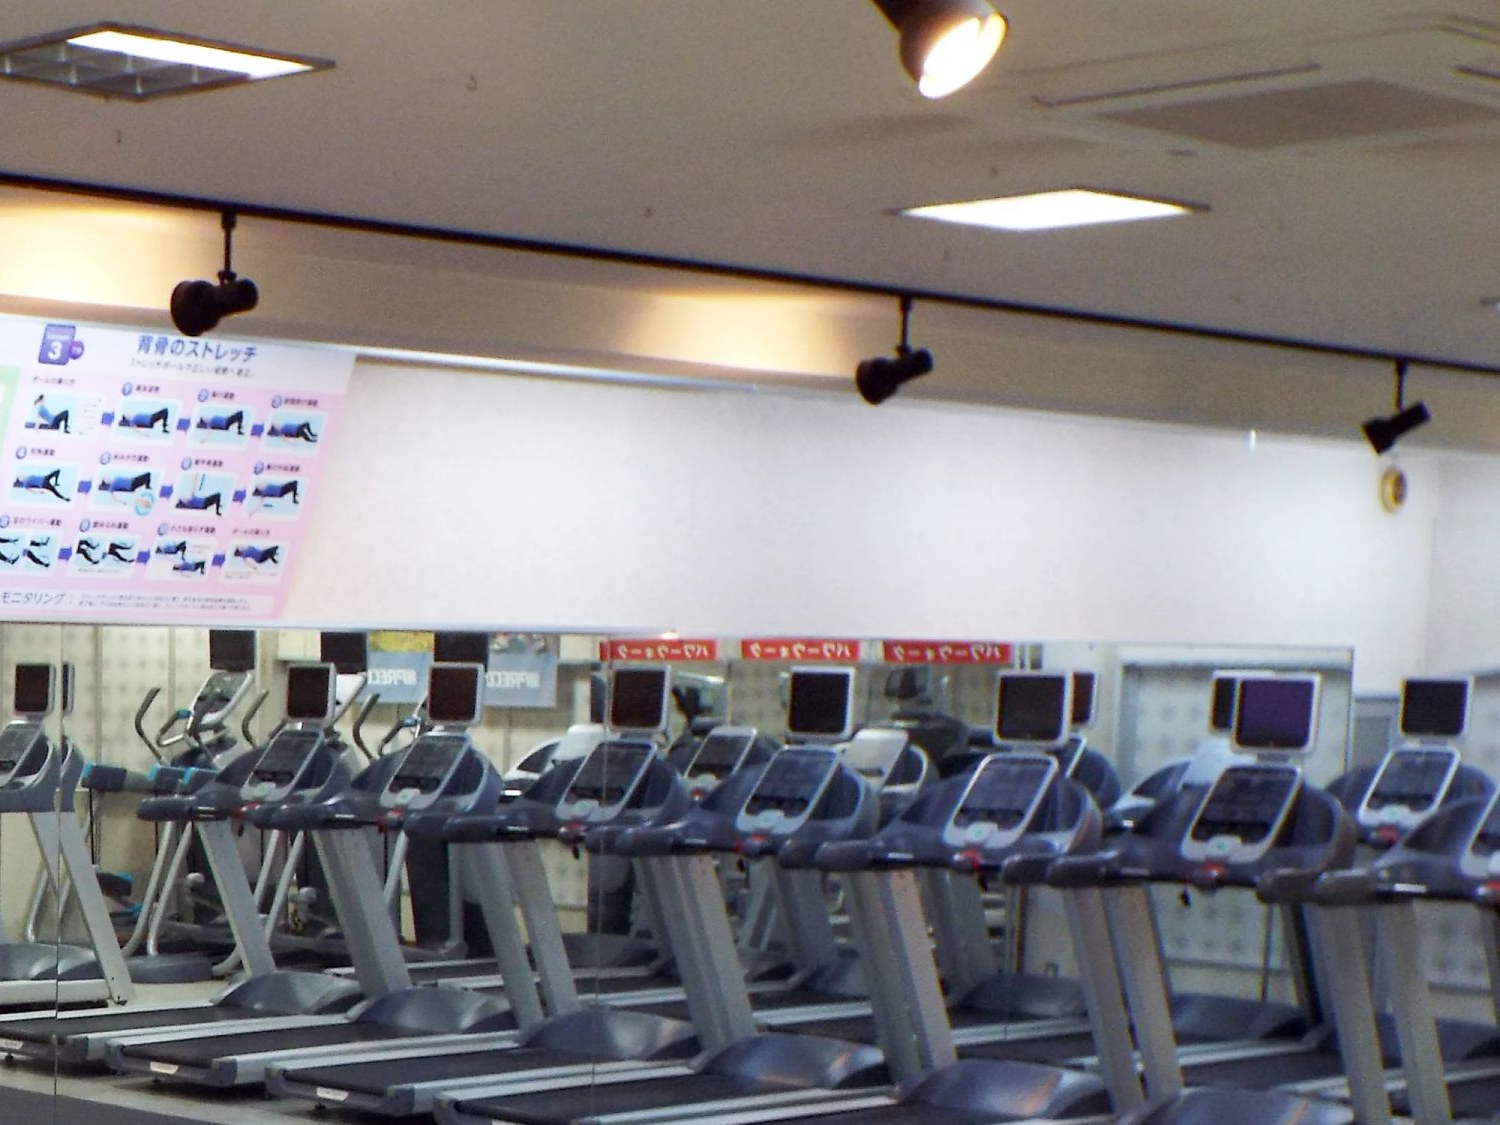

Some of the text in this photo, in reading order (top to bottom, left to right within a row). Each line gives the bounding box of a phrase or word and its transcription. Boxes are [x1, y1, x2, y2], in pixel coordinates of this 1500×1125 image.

[47, 339, 62, 360] 3
[136, 334, 258, 364] 背骨のストレッチ
